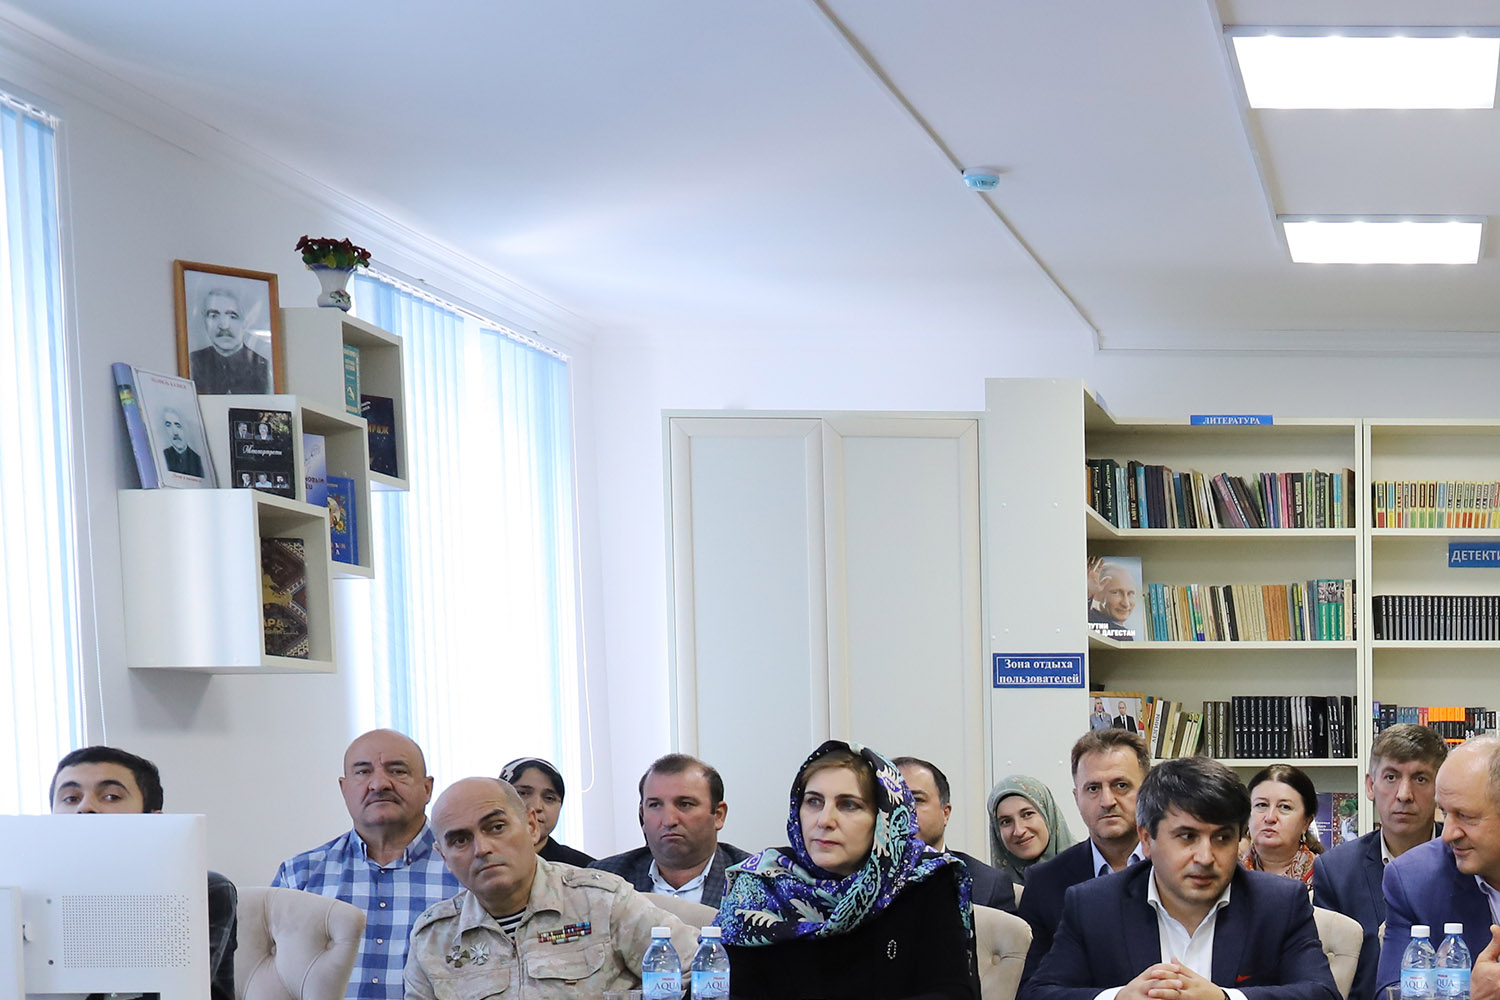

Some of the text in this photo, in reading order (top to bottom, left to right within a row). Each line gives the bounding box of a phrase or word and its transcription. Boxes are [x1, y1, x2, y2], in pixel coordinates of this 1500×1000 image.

[1202, 416, 1261, 425] ЛИТЕРАТУРА
[1101, 629, 1136, 638] ДАГЕСТАН
[1004, 658, 1073, 670] Зона отдыха
[999, 673, 1079, 684] пользователей
[654, 981, 680, 992] AQUA
[1403, 980, 1429, 990] AQUA
[1437, 978, 1455, 988] QUA
